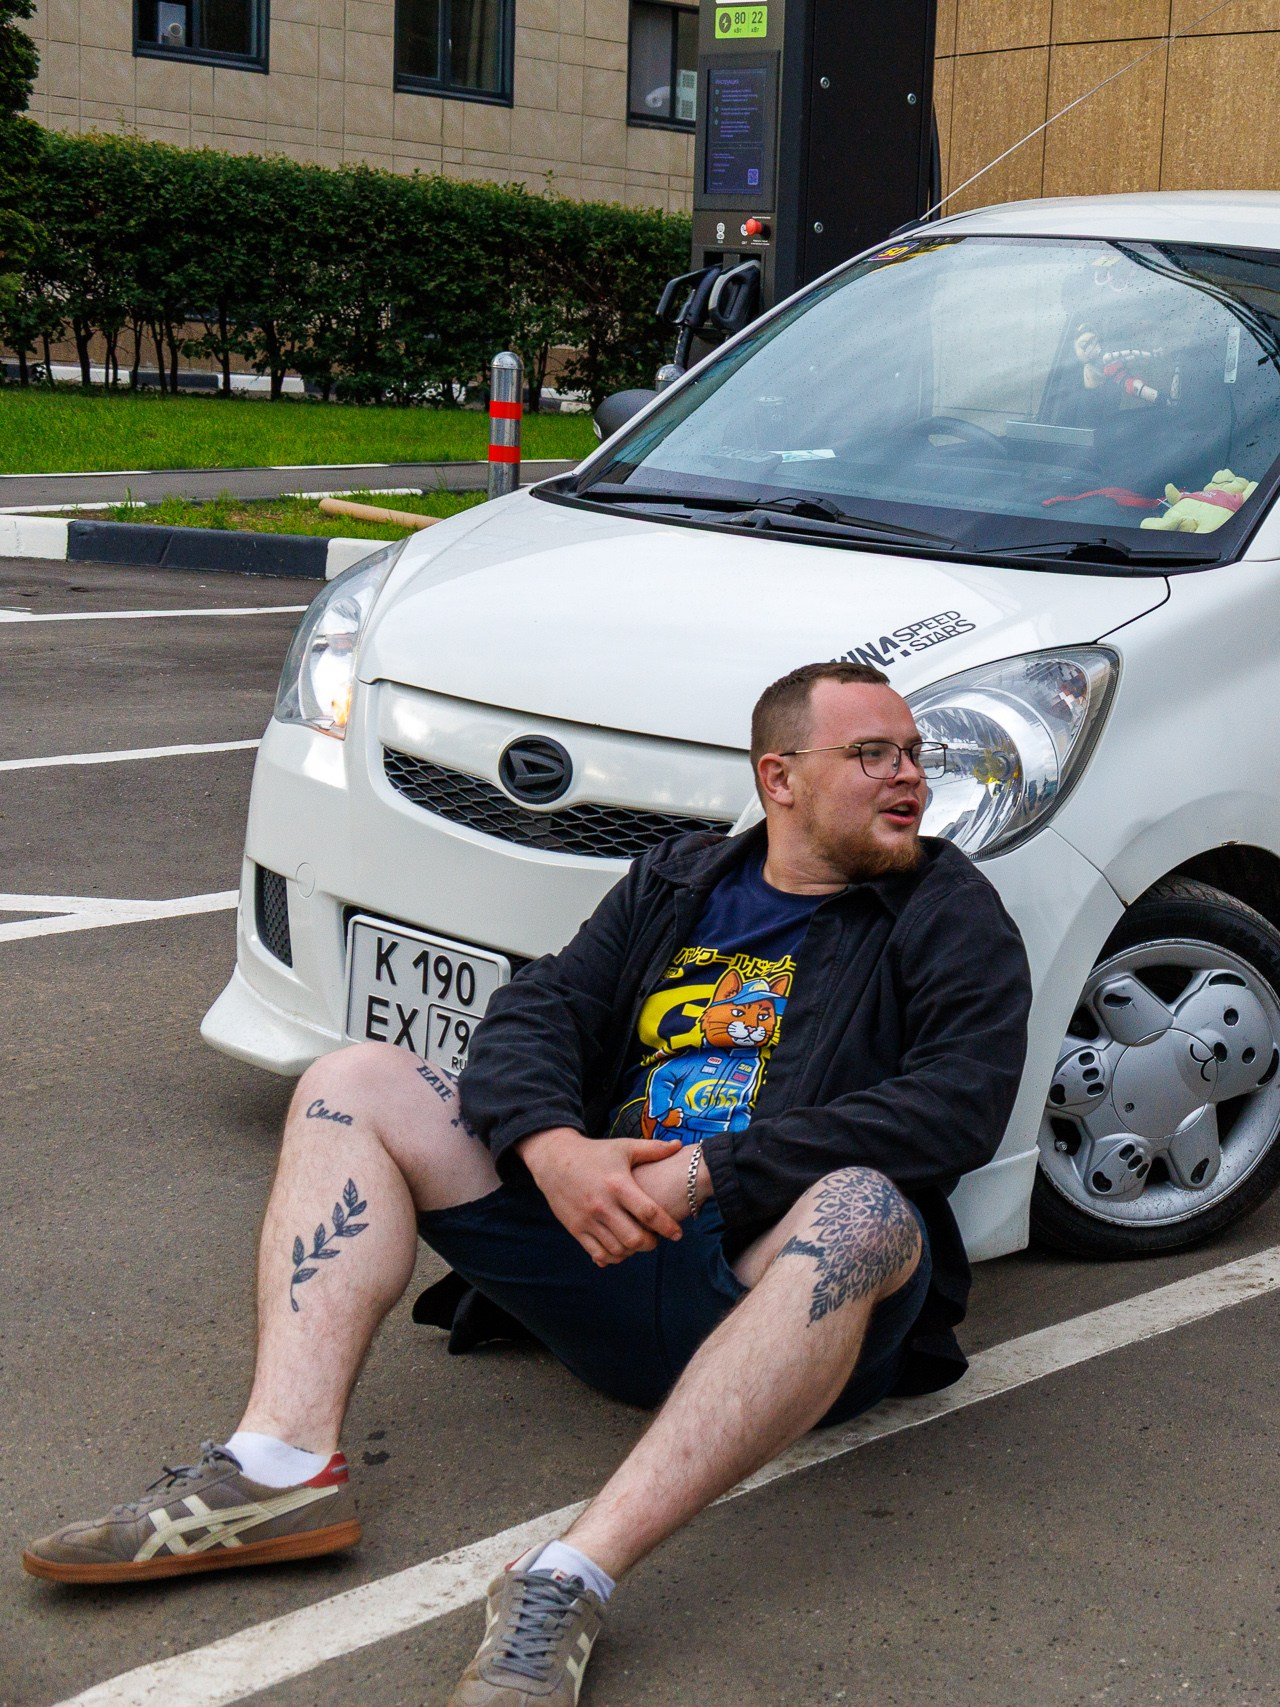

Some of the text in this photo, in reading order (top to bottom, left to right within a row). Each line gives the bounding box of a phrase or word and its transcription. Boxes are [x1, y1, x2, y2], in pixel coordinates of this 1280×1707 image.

[734, 11, 763, 24] 80 22
[892, 610, 961, 642] SPEED
[909, 619, 976, 652] STARS
[375, 936, 476, 1007] K 190
[366, 995, 419, 1053] EX
[452, 1056, 468, 1071] RU
[416, 1065, 456, 1102] HATE
[700, 1085, 738, 1109] 555
[306, 1099, 353, 1126] Сила
